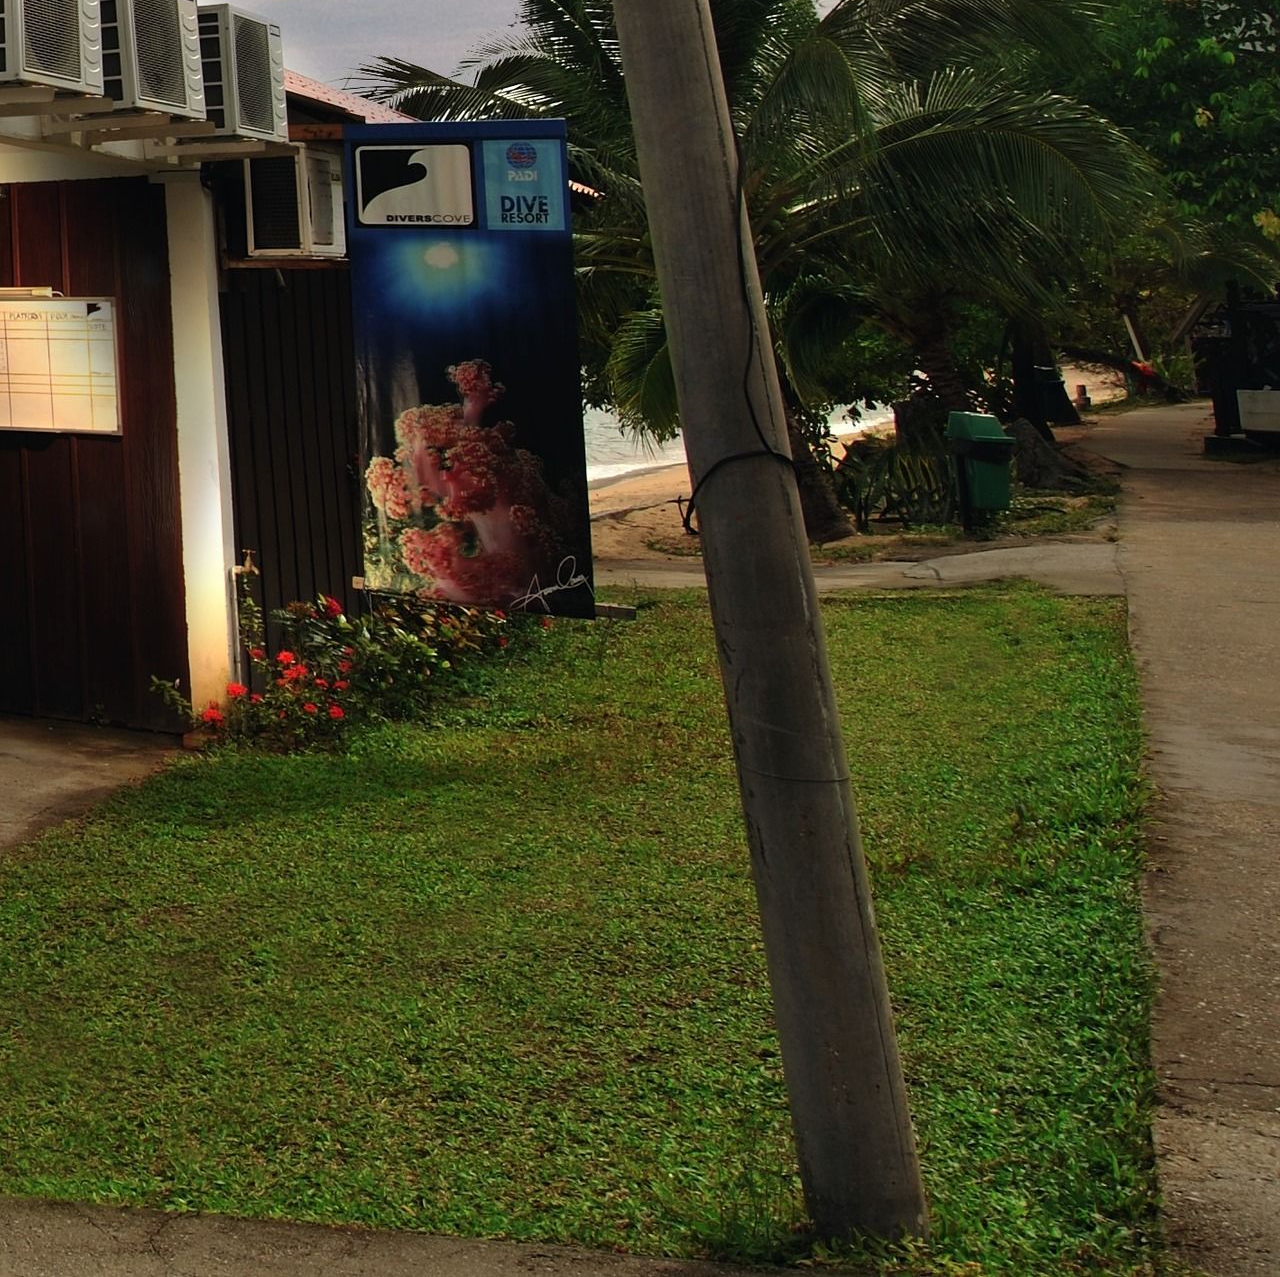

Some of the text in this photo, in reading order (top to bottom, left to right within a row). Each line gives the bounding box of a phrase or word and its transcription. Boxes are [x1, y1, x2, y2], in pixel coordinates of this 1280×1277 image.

[507, 170, 538, 182] PADI
[501, 195, 549, 213] DIVE
[386, 214, 471, 223] DIVERSCOVE
[502, 212, 549, 224] RESORT
